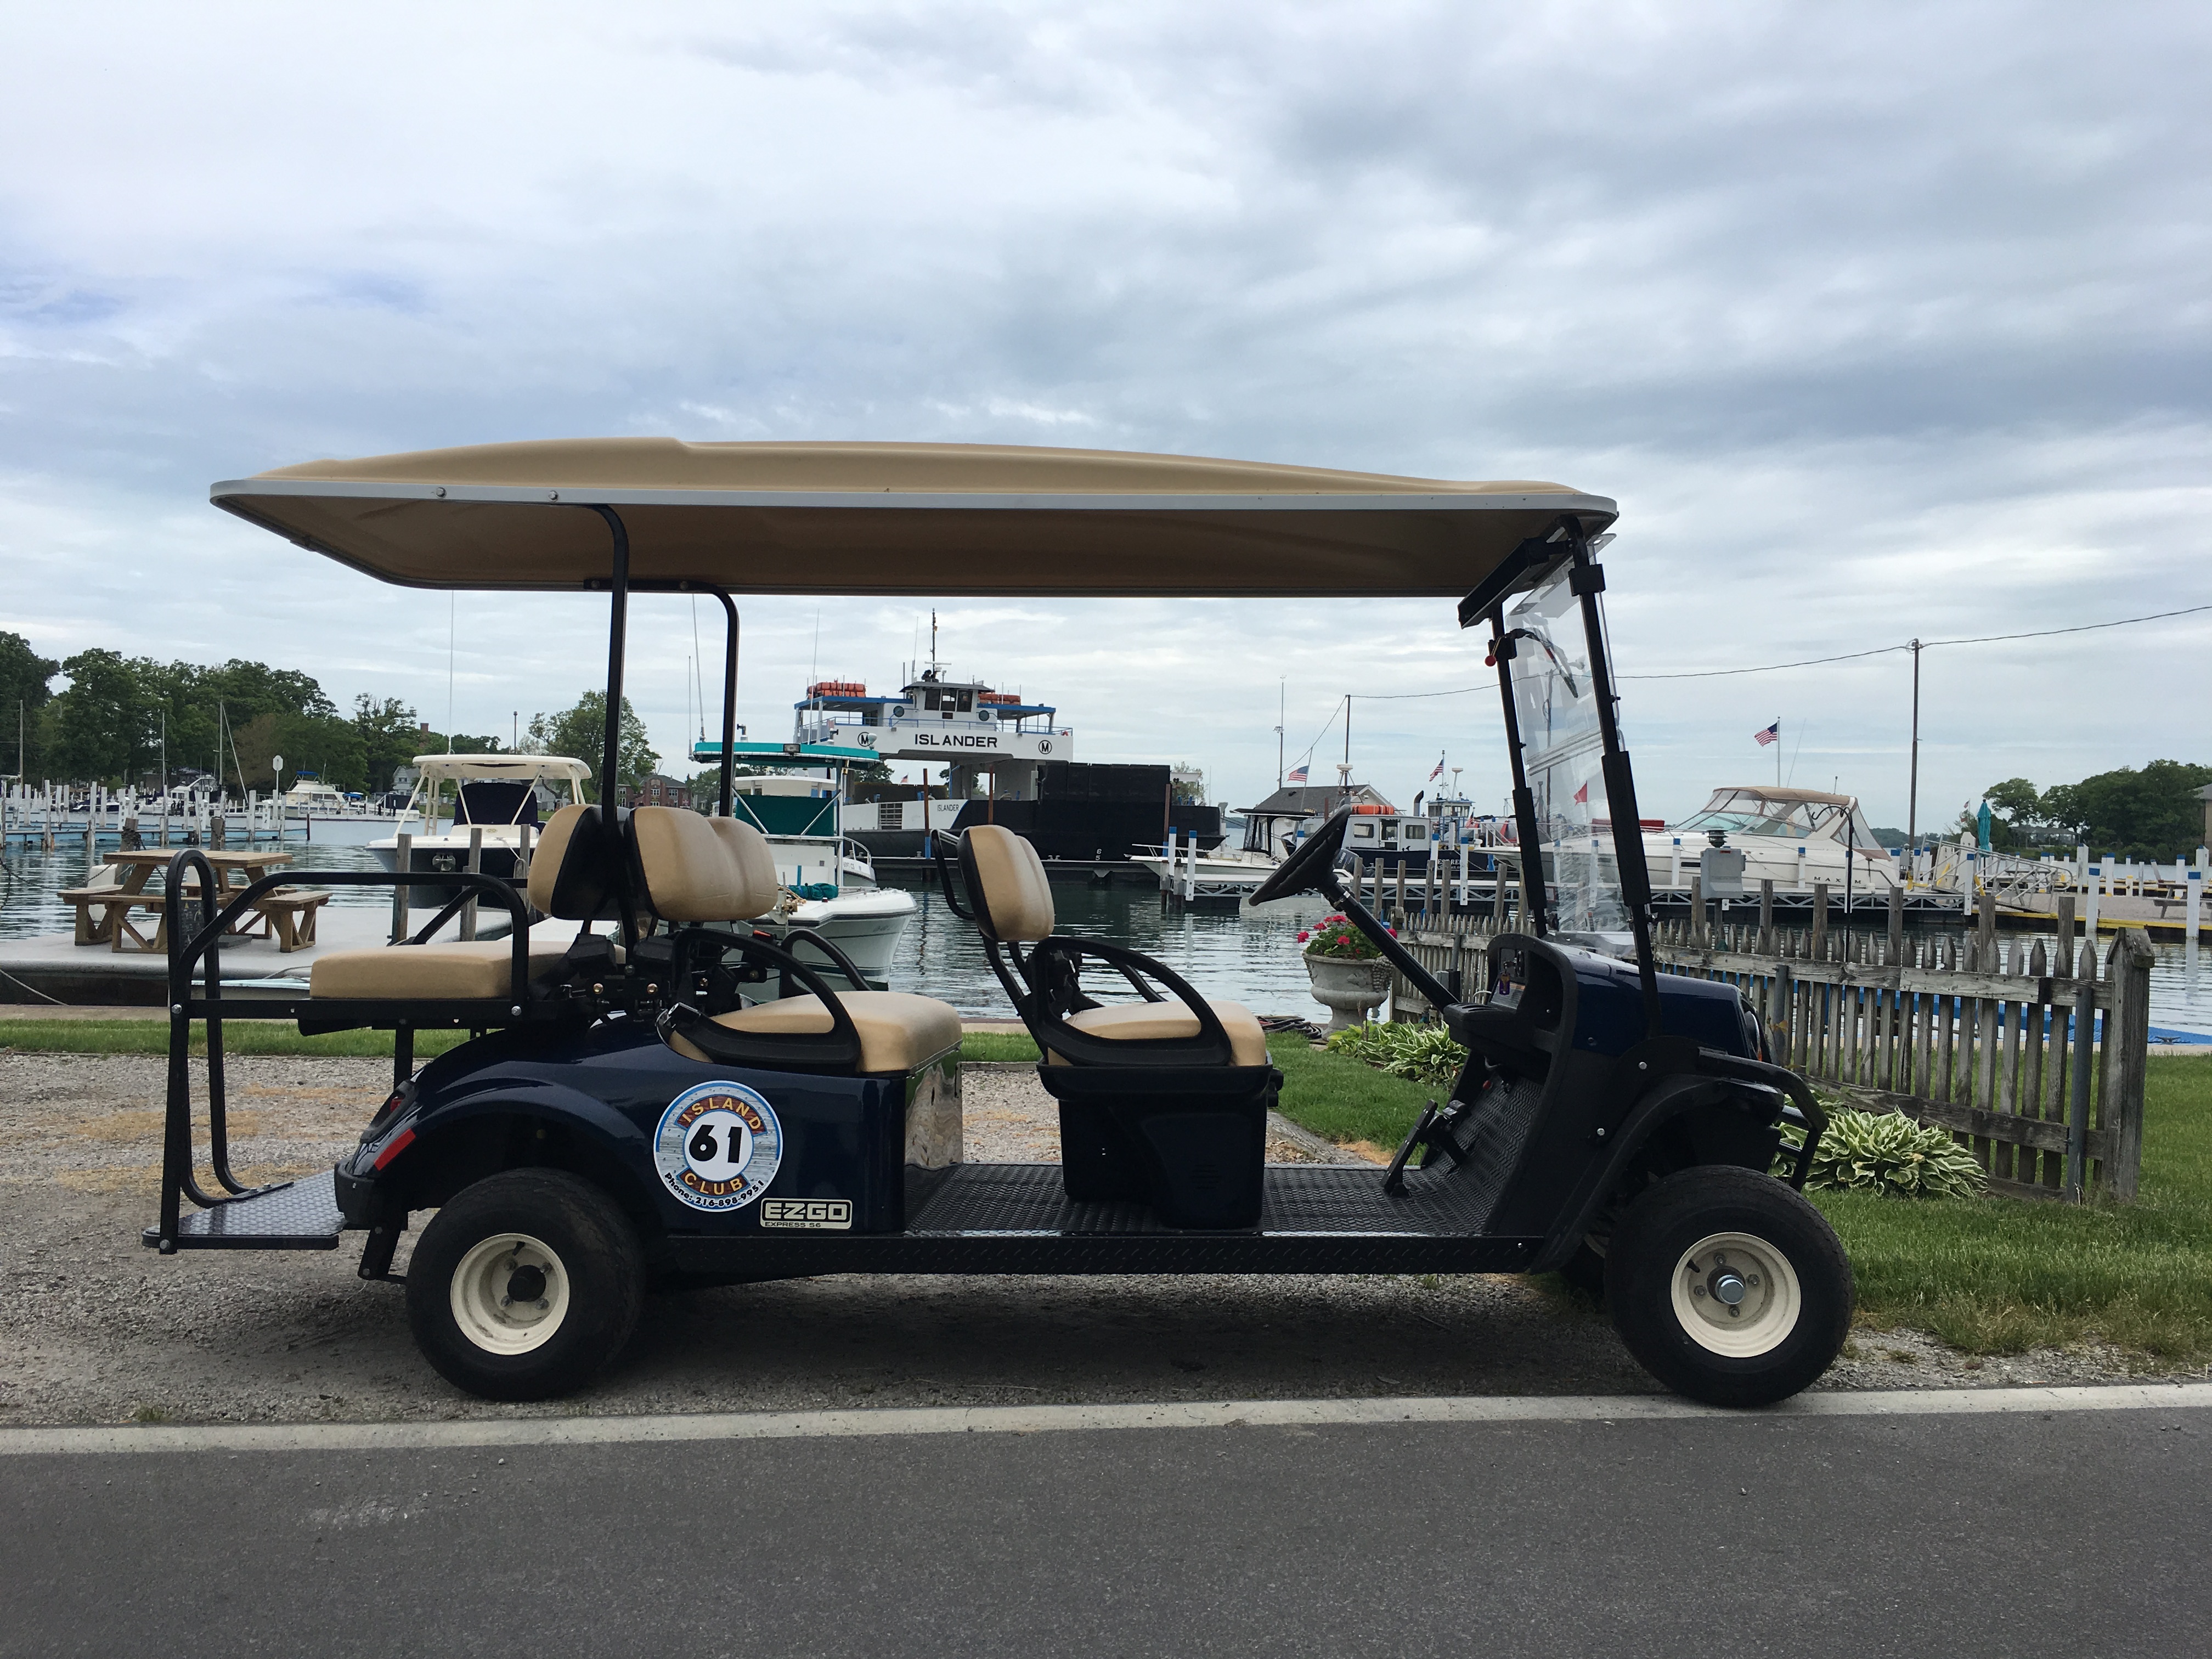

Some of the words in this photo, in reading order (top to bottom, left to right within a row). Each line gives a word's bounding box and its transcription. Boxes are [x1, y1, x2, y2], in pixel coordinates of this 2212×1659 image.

[915, 733, 997, 748] ISLANDER
[937, 804, 960, 812] ISLANDER
[1814, 876, 1861, 884] MAXM
[682, 1097, 761, 1130] ISLAND
[689, 1124, 743, 1164] 61
[685, 1172, 743, 1195] CLUB
[695, 1180, 765, 1207] 216-898-9951
[765, 1202, 848, 1220] EZGO
